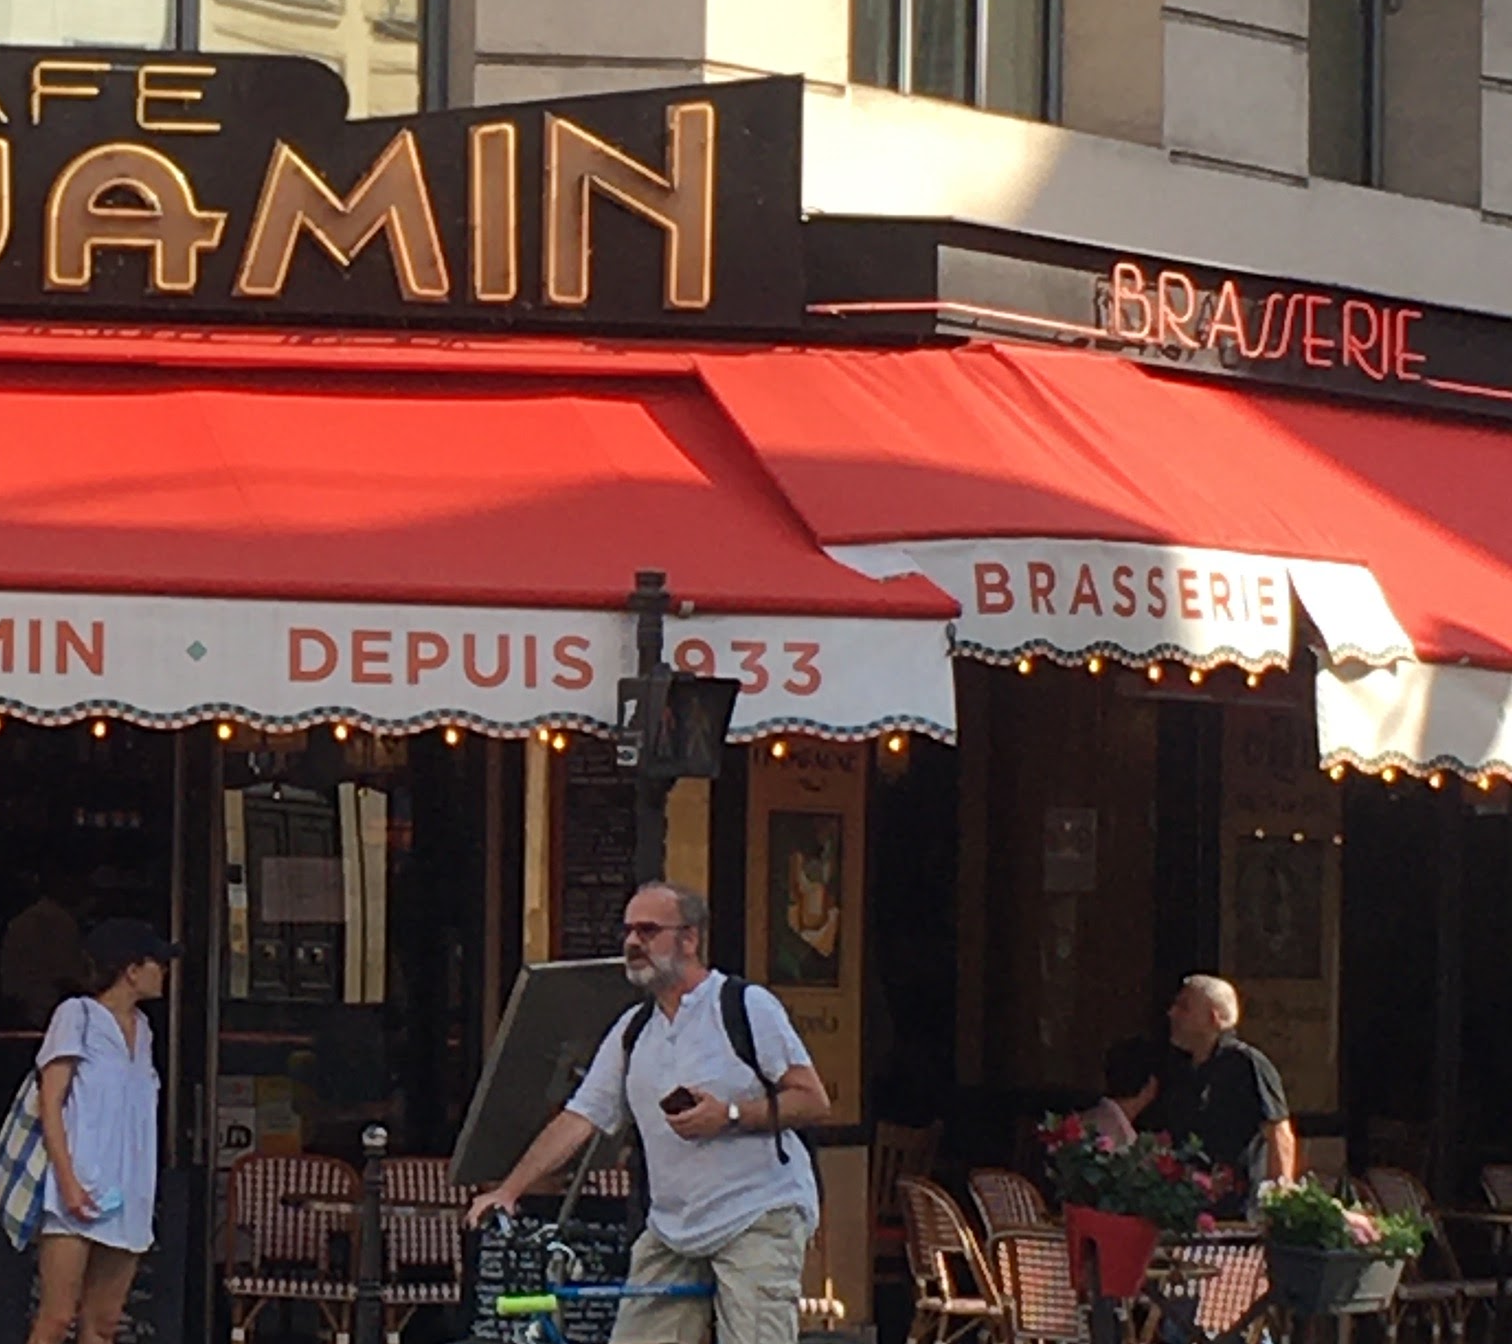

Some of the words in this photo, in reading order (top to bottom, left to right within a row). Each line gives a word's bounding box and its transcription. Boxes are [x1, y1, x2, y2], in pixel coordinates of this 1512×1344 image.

[1113, 261, 1427, 382] BRASSERIE
[974, 561, 1280, 627] BRASSERIE
[289, 626, 595, 690] DEPUIS
[672, 637, 823, 697] 933
